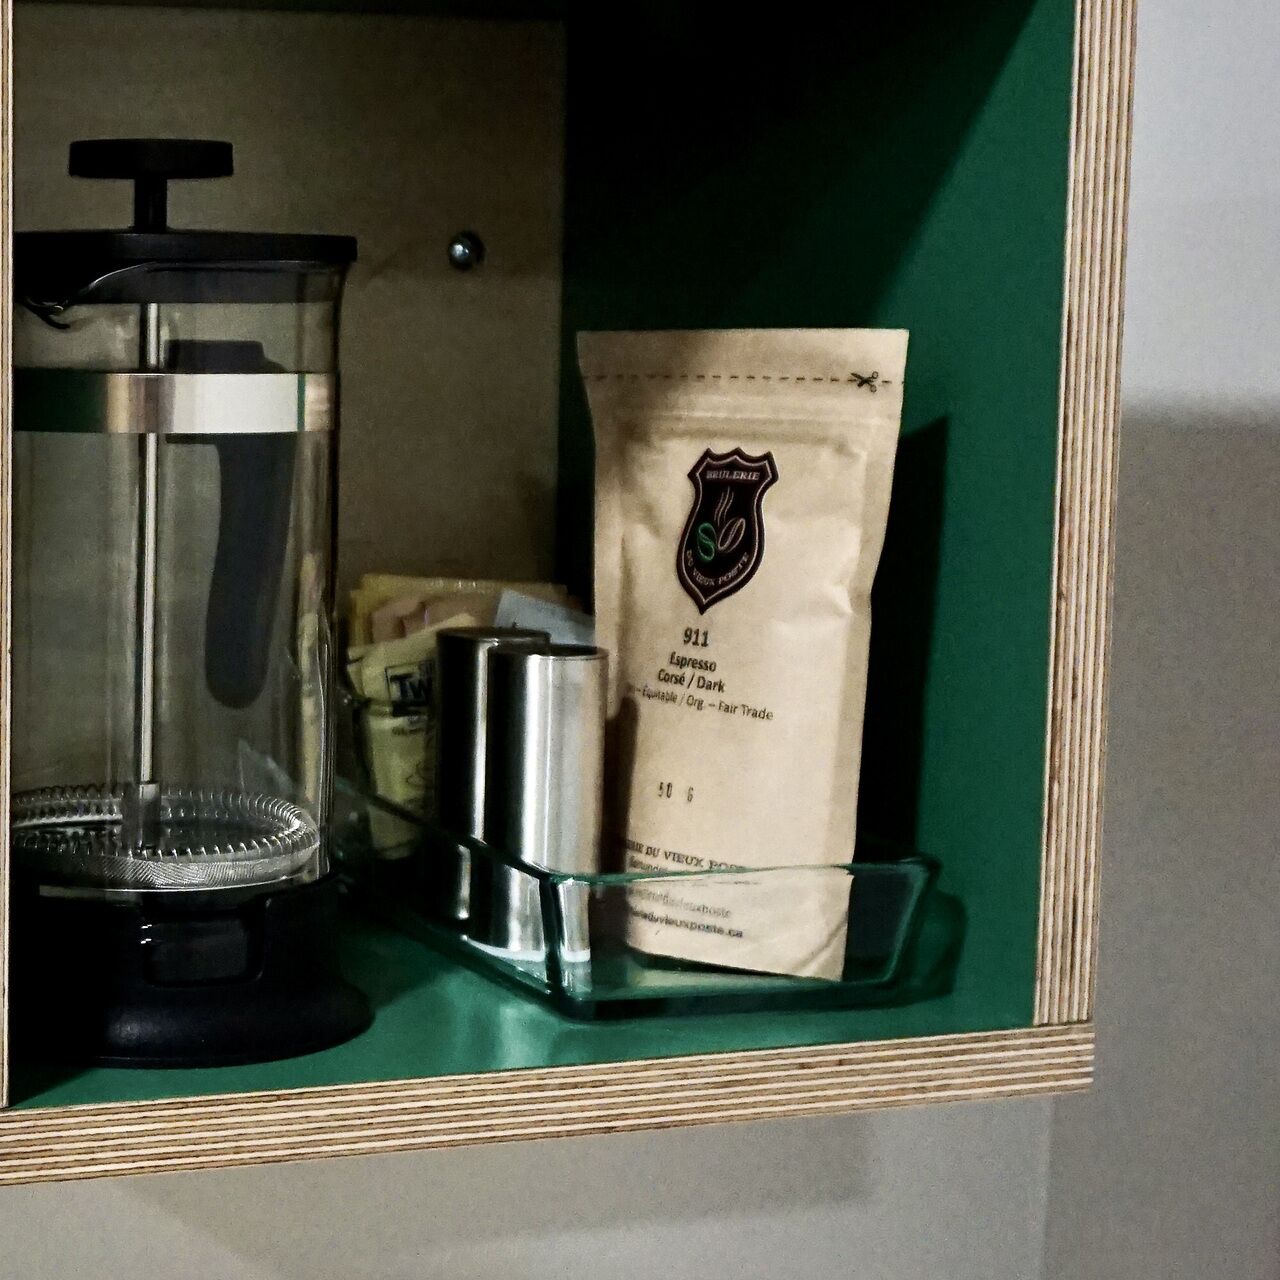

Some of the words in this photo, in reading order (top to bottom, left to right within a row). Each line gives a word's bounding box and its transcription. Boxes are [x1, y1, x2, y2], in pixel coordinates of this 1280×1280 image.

[683, 627, 709, 647] 911
[670, 651, 717, 672] Espresso
[658, 669, 685, 686] Corsé
[697, 676, 725, 693] Dark
[718, 701, 738, 715] Fair
[741, 704, 773, 720] Trade
[664, 850, 704, 869] VIEUX
